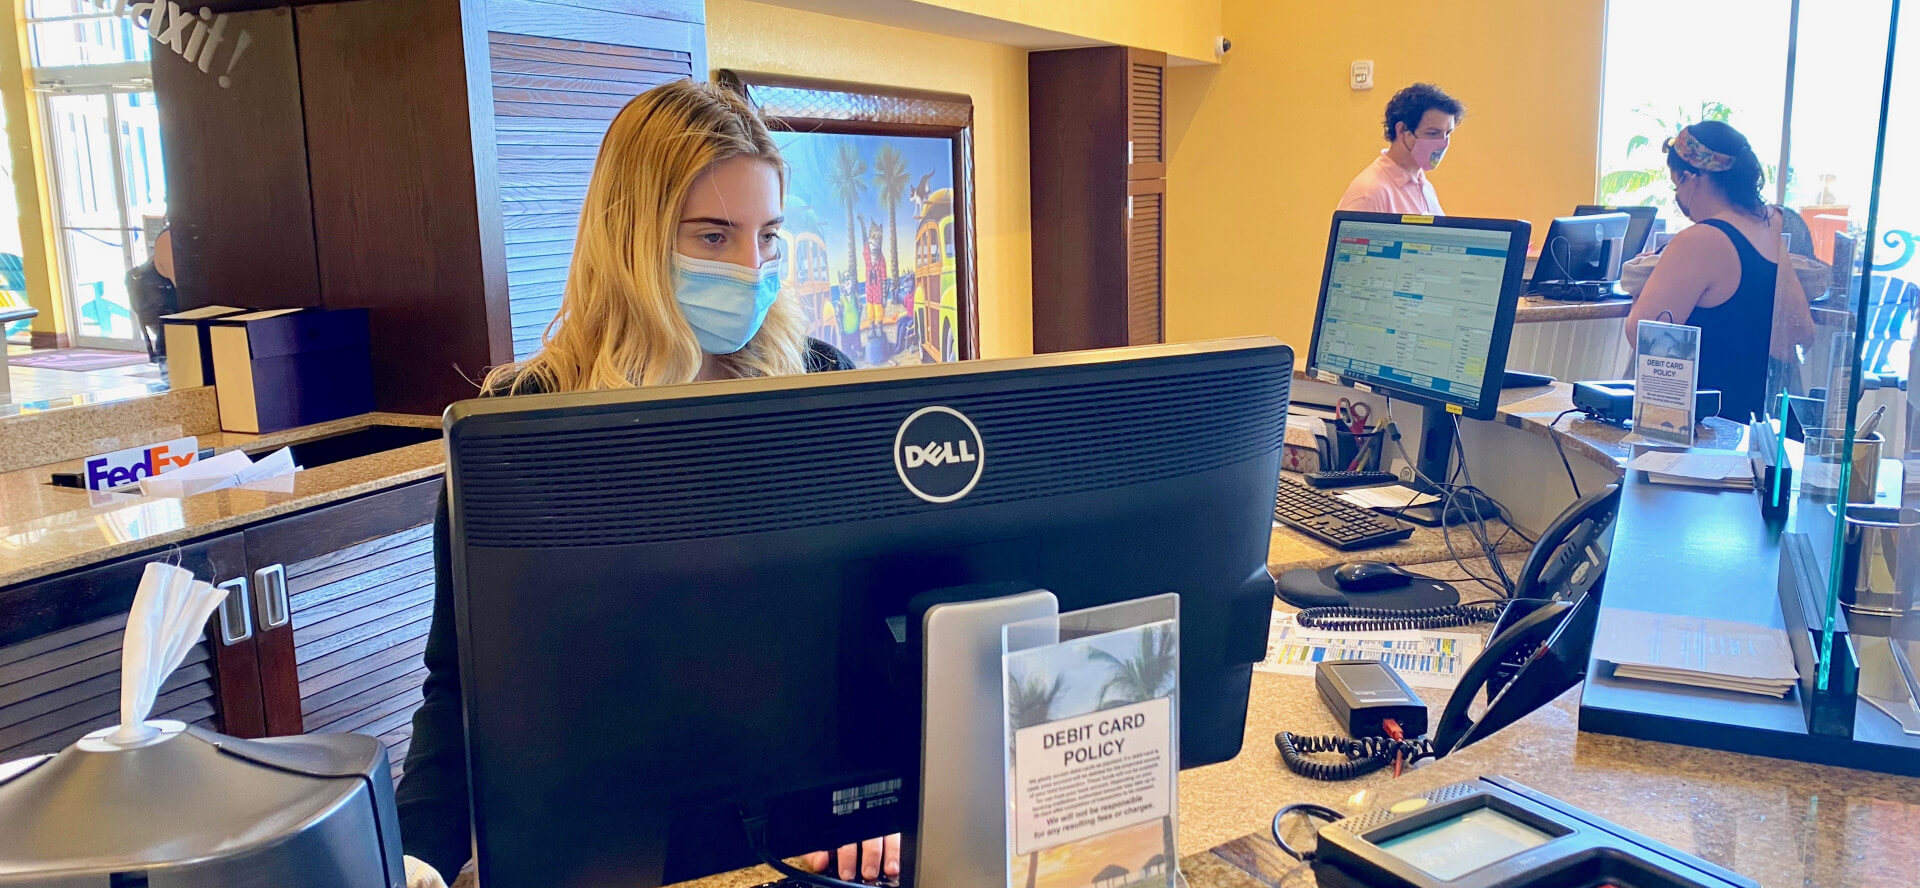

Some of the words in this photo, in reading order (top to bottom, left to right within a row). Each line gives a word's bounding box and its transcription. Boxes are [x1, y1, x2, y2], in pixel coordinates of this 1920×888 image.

[97, 0, 251, 88] axit!
[1647, 359, 1665, 367] DEBIT
[1666, 361, 1684, 370] CARD
[1653, 368, 1677, 377] POLICY
[904, 440, 975, 468] DELL
[1043, 724, 1093, 750] DEBIT
[1098, 712, 1145, 736] CARD
[1064, 738, 1125, 766] POLICY
